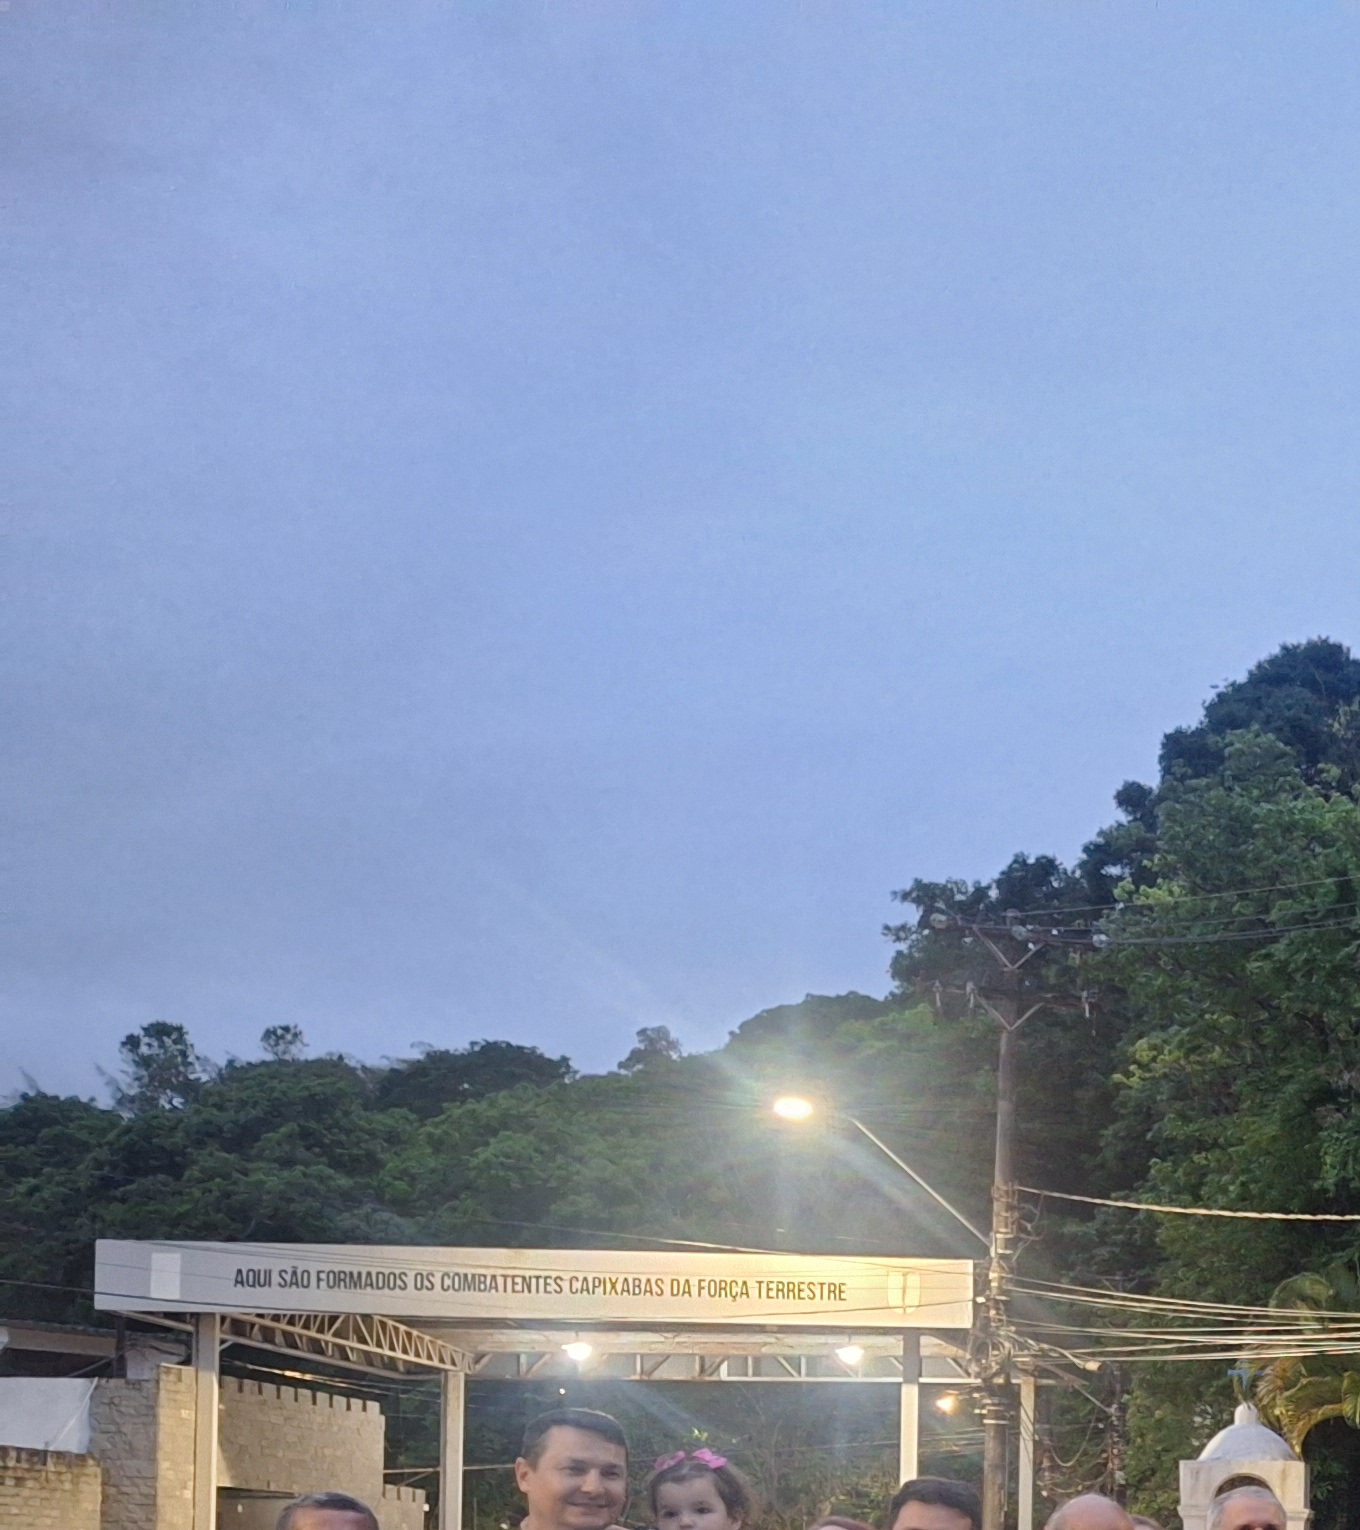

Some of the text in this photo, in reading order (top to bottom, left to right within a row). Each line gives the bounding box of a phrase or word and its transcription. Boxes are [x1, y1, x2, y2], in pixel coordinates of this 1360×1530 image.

[234, 1266, 847, 1303] AQUI SÃO FORMADOS OS COMBATENTES CAPIXABAS DA FORÇA TERRESTRE
